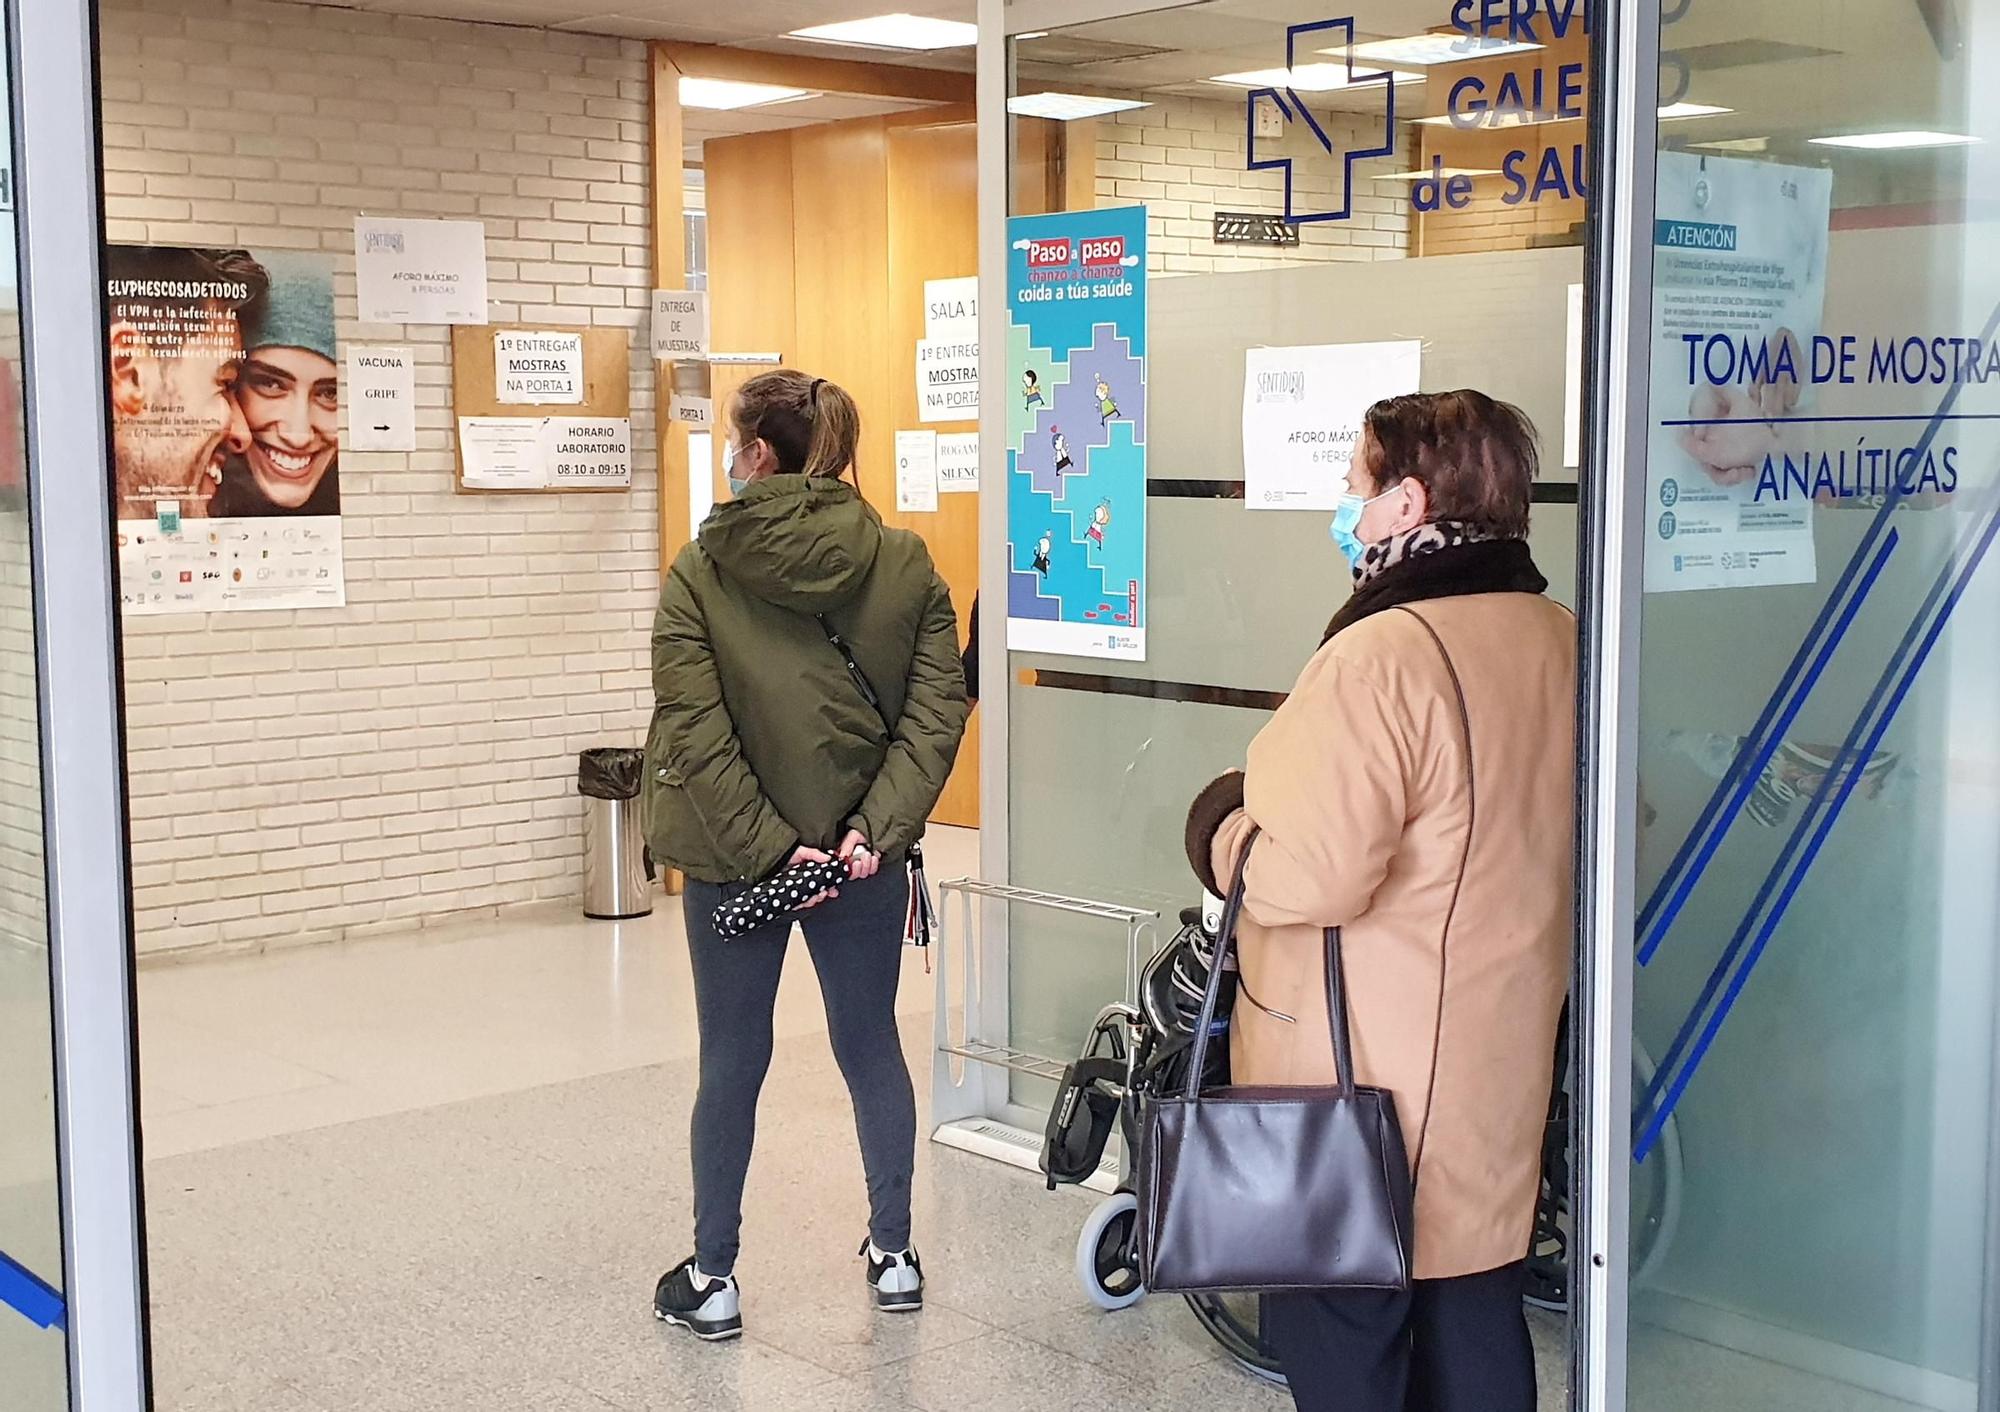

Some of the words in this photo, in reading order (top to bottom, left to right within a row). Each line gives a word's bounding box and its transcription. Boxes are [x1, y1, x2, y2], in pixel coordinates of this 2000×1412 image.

[1447, 63, 1583, 129] GALE
[1412, 155, 1473, 212] de
[1667, 225, 1734, 248] ATENCIÓN
[1030, 244, 1067, 263] Paso
[1071, 249, 1077, 260] a
[1082, 241, 1121, 264] paso
[392, 272, 422, 281] AFORO
[1028, 269, 1068, 283] chanzo
[1071, 270, 1078, 280] a
[1081, 266, 1123, 280] chanzo
[107, 279, 247, 299] ELVPHESCOSADETODOS
[1018, 284, 1052, 302] coida
[1056, 286, 1063, 300] a
[1067, 281, 1089, 299] túa
[1093, 279, 1132, 298] saúde
[117, 304, 127, 317] El
[130, 304, 150, 317] VPH
[166, 305, 177, 318] la
[226, 307, 237, 320] de
[660, 301, 695, 313] ENTREGA
[930, 300, 966, 320] SALA
[970, 299, 977, 317] 1
[183, 320, 214, 332] sexual
[671, 320, 681, 333] DE
[156, 333, 183, 345] entre
[500, 339, 512, 351] 1º
[516, 339, 577, 352] ENTREGAR
[658, 340, 700, 353] MUESTRAS
[358, 357, 403, 368] VACUNA
[509, 359, 567, 371] MOSTRAS
[1682, 333, 1798, 386] TOMA
[1811, 335, 1857, 384] DE
[929, 367, 978, 383] MOSTRA
[506, 380, 523, 391] NA
[526, 380, 564, 391] PORTA
[566, 380, 573, 391] 1
[365, 388, 399, 399] GRIPE
[927, 393, 944, 406] NA
[680, 407, 699, 420] PORTA
[700, 409, 704, 421] 1
[568, 427, 614, 437] HORARIO
[1287, 431, 1326, 443] AFORO
[557, 443, 626, 454] LABORATORIO
[941, 444, 979, 457] ROGAM
[1313, 450, 1319, 463] 6
[557, 464, 586, 475] 08:10
[589, 466, 595, 475] a
[598, 464, 626, 475] 09:15
[1754, 436, 1958, 502] ANALÍTICAS
